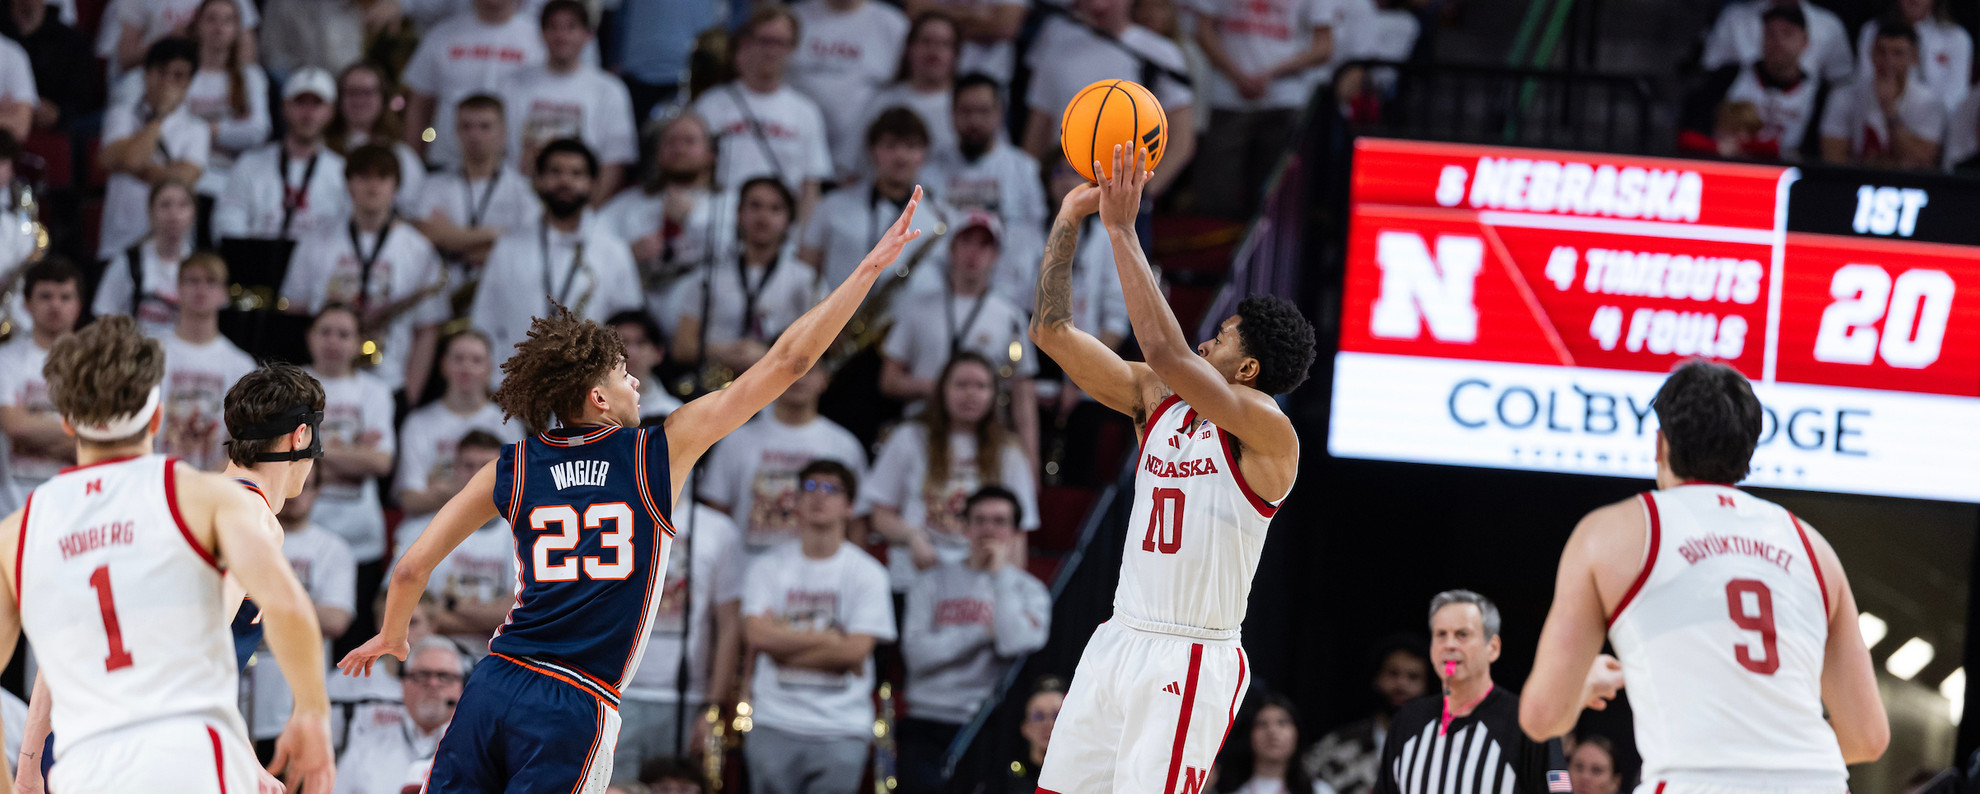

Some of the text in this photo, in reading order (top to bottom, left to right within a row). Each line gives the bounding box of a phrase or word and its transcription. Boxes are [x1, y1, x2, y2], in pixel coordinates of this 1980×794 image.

[1469, 156, 1703, 223] NEBRASKA
[1852, 184, 1929, 238] 1ST
[1371, 229, 1485, 344] N
[1545, 245, 1763, 304] 4 TIMEOUTS
[1589, 305, 1748, 360] 4 FOULS
[1812, 262, 1956, 369] 20
[1447, 378, 1659, 436] COLBY
[550, 459, 610, 491] WAGLER
[59, 520, 135, 561] HOIBERG
[528, 501, 635, 583] 23
[1142, 486, 1186, 554] 10
[89, 563, 133, 673] 1
[1725, 577, 1780, 677] 9
